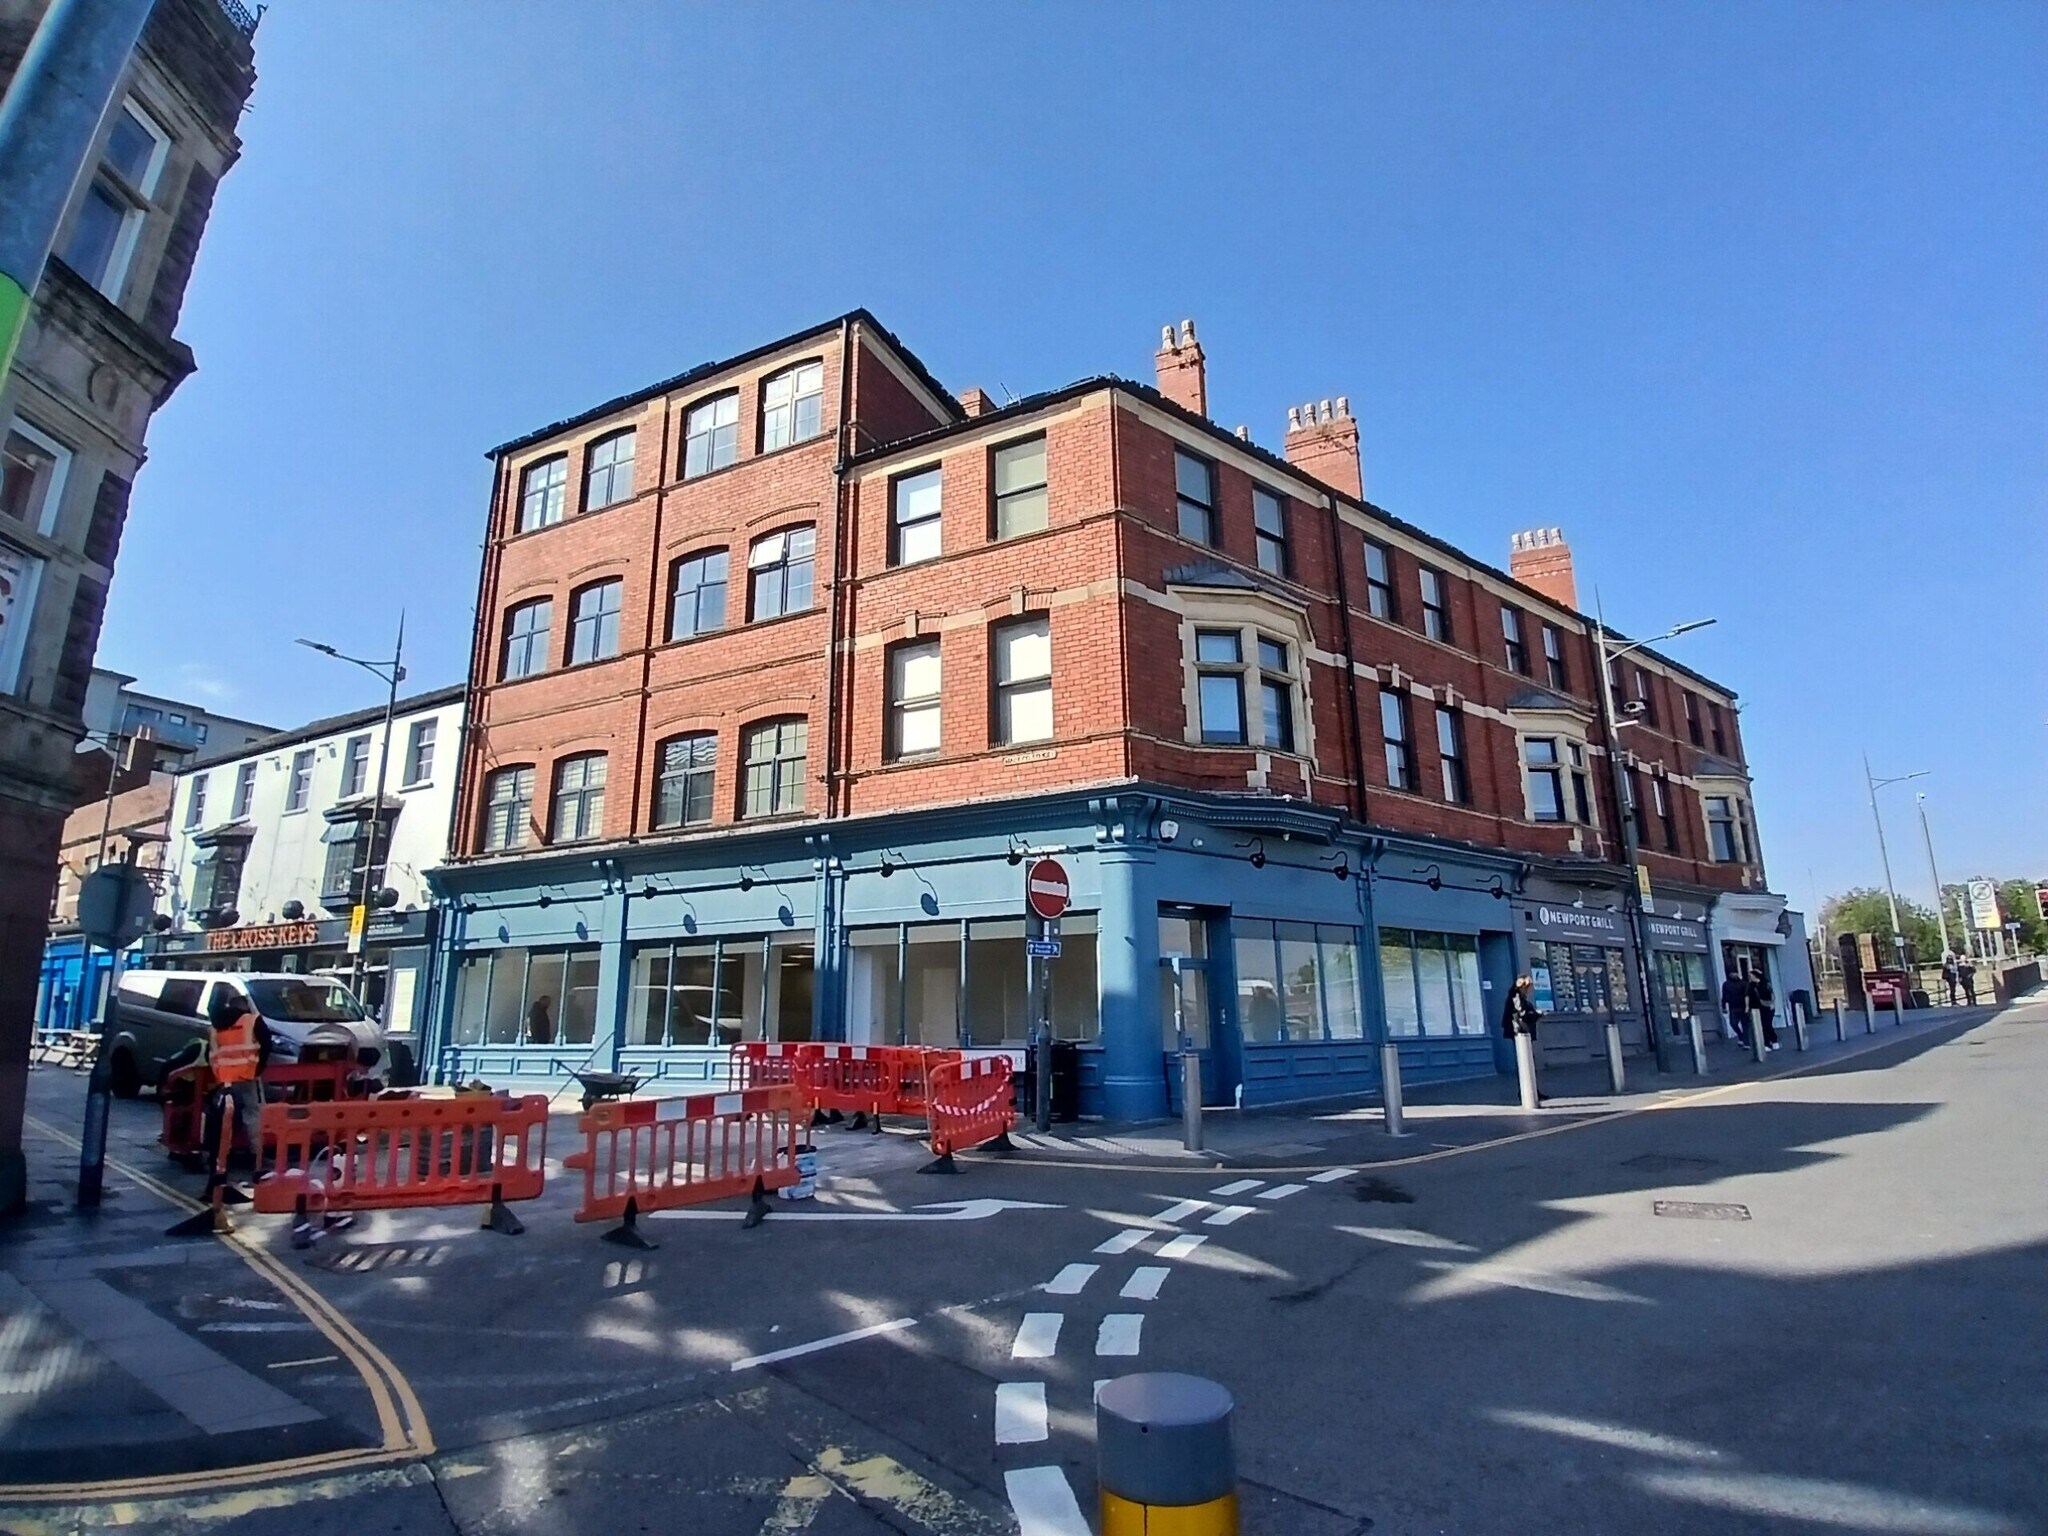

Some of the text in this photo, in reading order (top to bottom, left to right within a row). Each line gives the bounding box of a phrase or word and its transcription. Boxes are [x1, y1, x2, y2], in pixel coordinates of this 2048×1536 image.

[1550, 911, 1614, 930] NEWPORT GRILL
[206, 931, 230, 950] THE
[231, 927, 276, 948] CROSS
[279, 923, 319, 944] KEYS
[1650, 923, 1697, 938] NEWPORT GRILL
